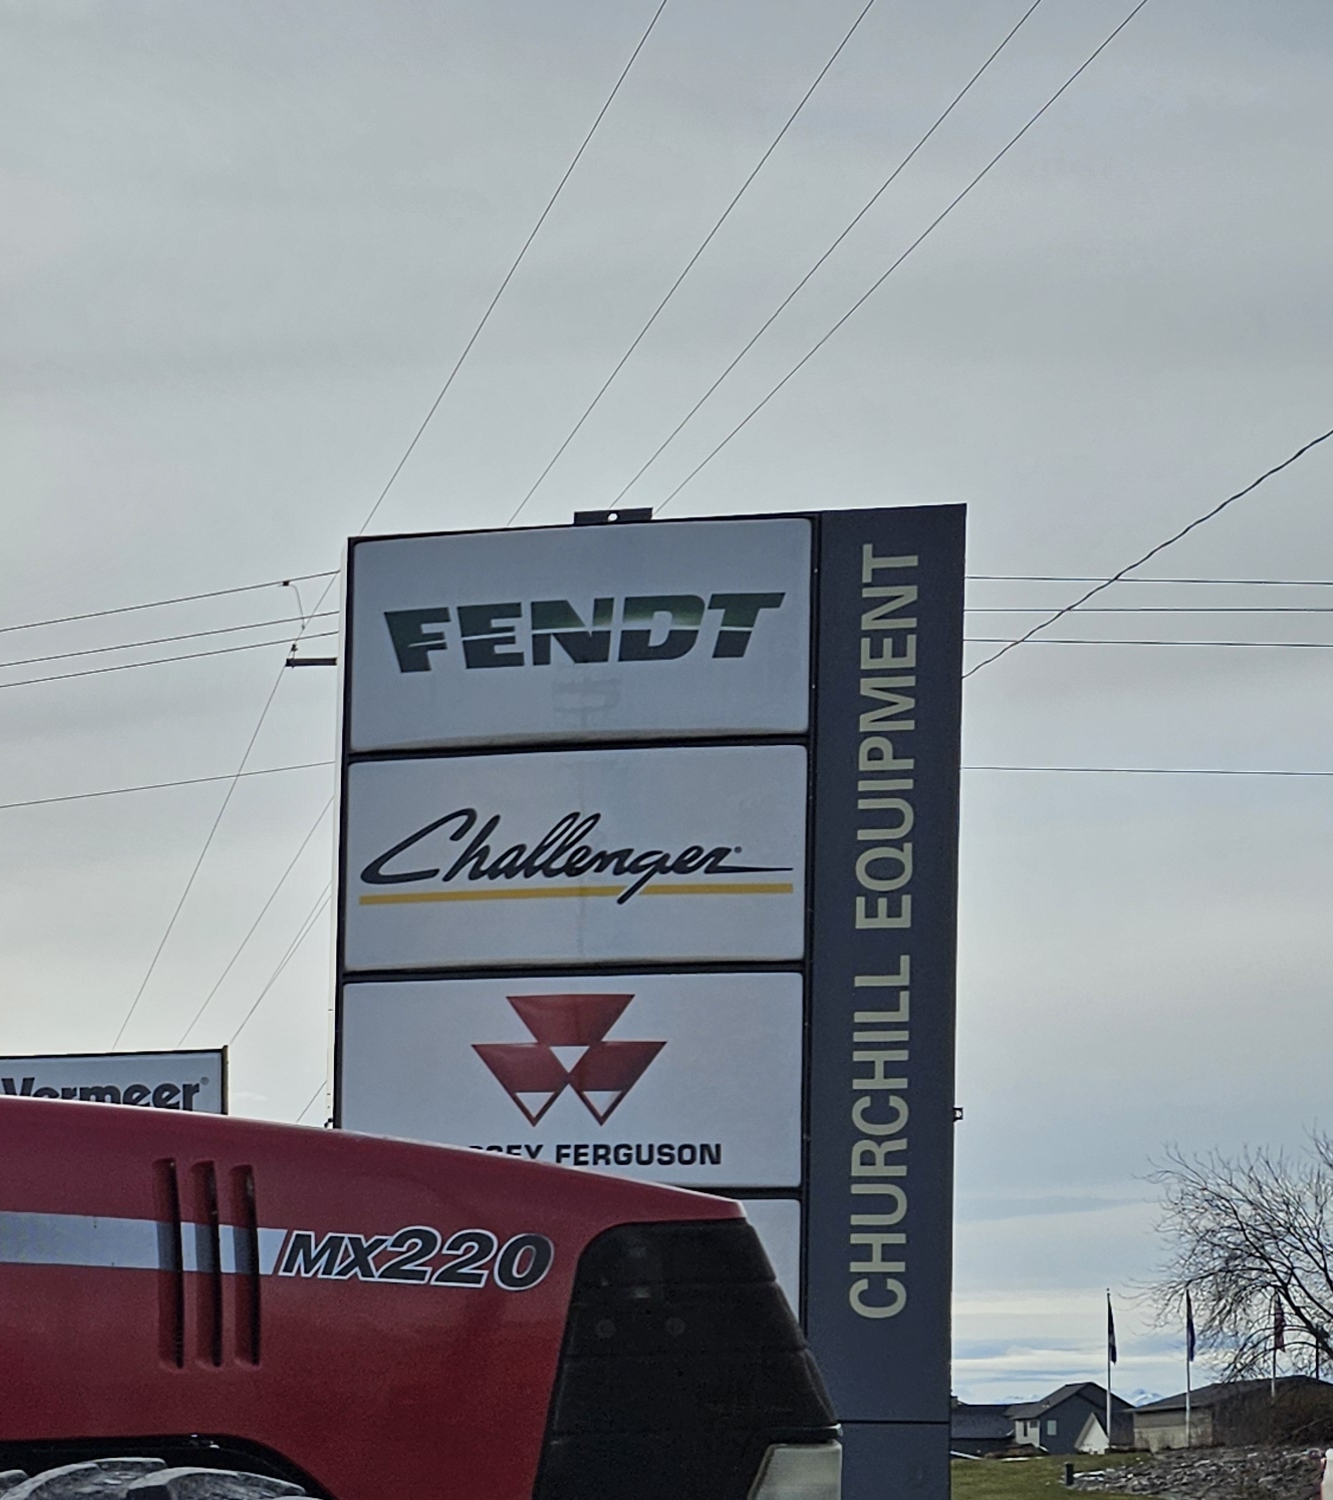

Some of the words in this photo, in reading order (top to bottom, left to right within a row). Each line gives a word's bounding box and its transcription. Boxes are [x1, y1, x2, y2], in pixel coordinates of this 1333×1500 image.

[384, 591, 786, 674] FENDT
[855, 543, 918, 929] EQUIPMENT
[360, 807, 794, 905] Challenger
[555, 1143, 722, 1166] FERGUSON
[849, 955, 910, 1319] CHURCHILL
[278, 1225, 555, 1292] MX220
